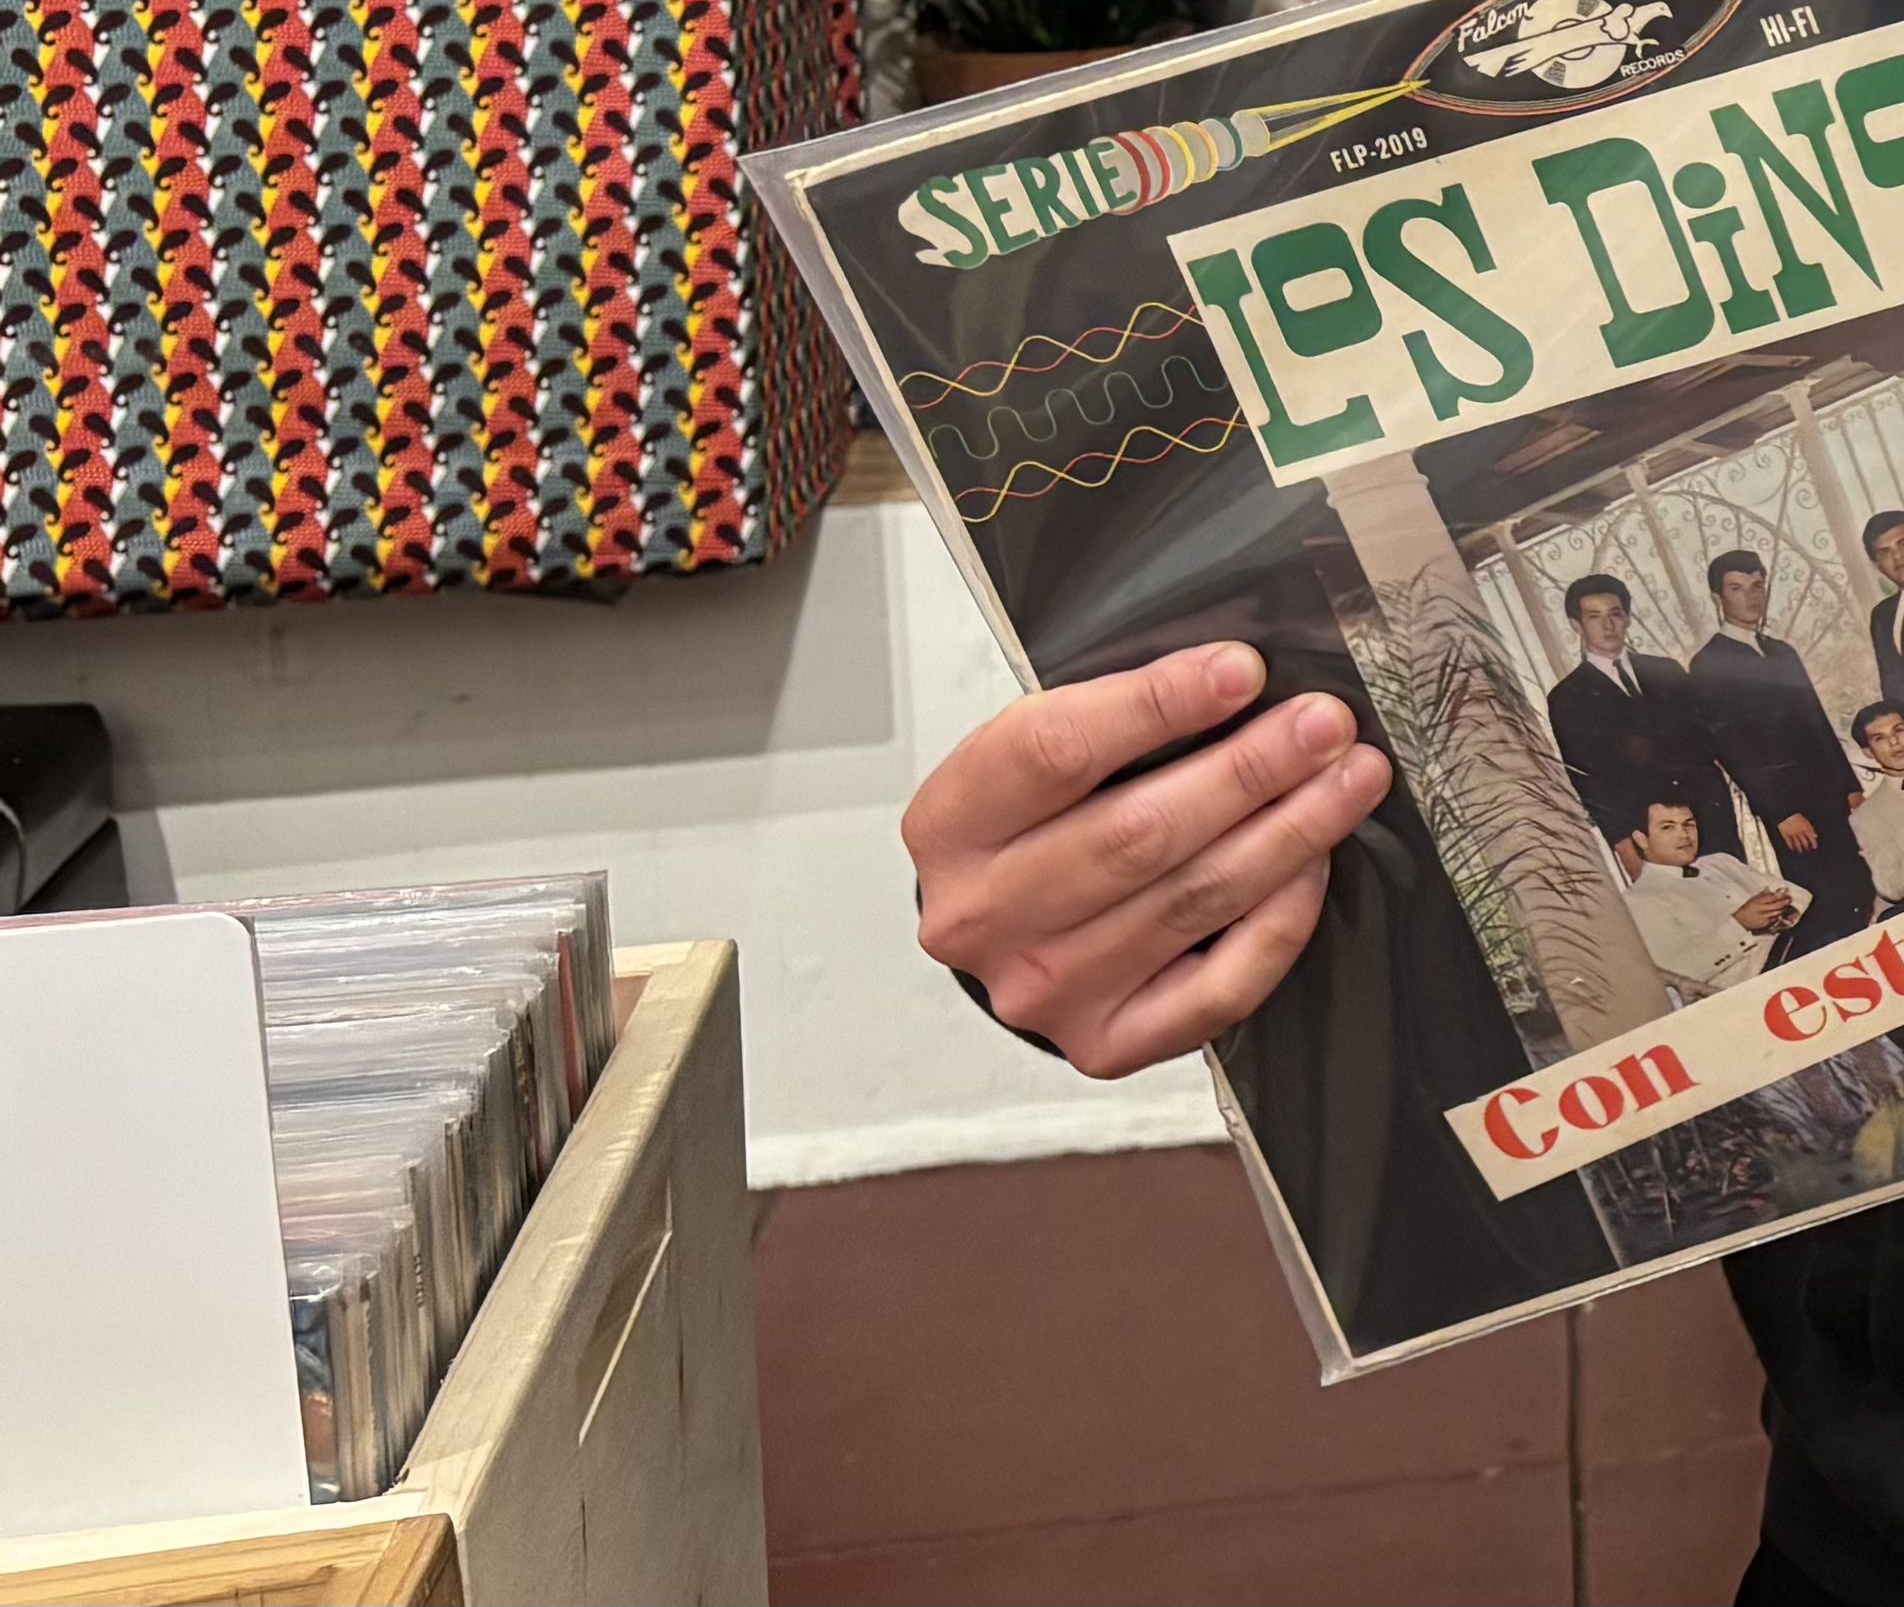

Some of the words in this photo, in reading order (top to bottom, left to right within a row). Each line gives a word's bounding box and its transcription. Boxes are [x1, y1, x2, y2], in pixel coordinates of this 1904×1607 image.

[1456, 1, 1534, 52] Falcon
[1760, 5, 1821, 48] HI-FI
[1619, 47, 1688, 78] RECORDS
[1330, 126, 1428, 173] FLP-2019
[912, 136, 1139, 270] SERIE
[1187, 184, 1535, 469] LOS
[1482, 1042, 1697, 1162] Con
